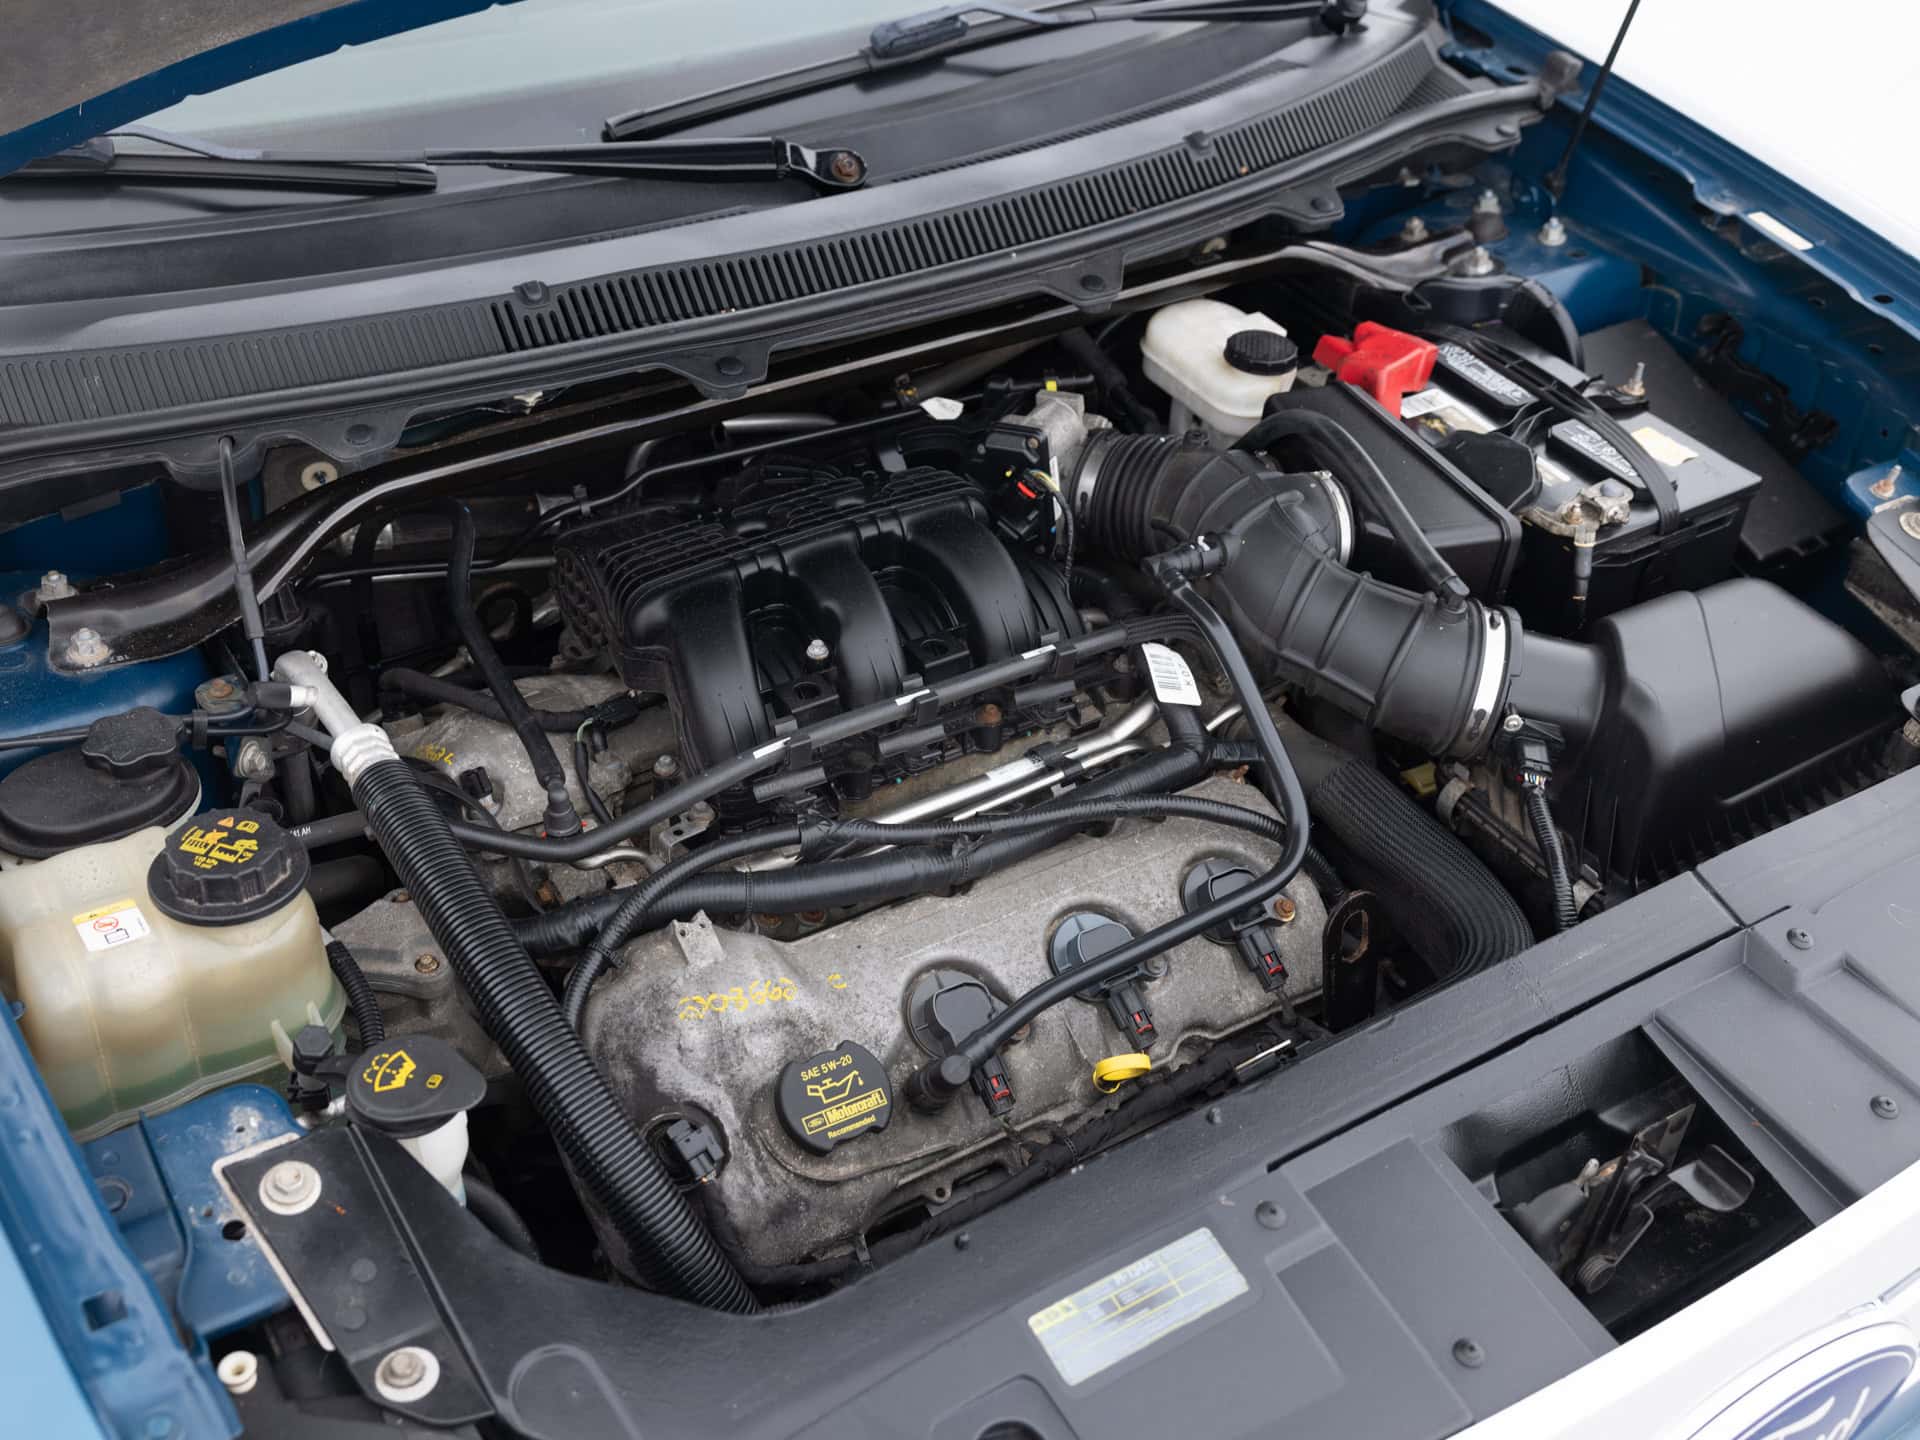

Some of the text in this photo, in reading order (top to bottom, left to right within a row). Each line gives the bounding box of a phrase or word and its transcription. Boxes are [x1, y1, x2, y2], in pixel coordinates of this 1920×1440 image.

[801, 1054, 853, 1081] SAE 5W-20
[826, 1091, 884, 1123] Motorcraft
[827, 1113, 877, 1139] Recommended
